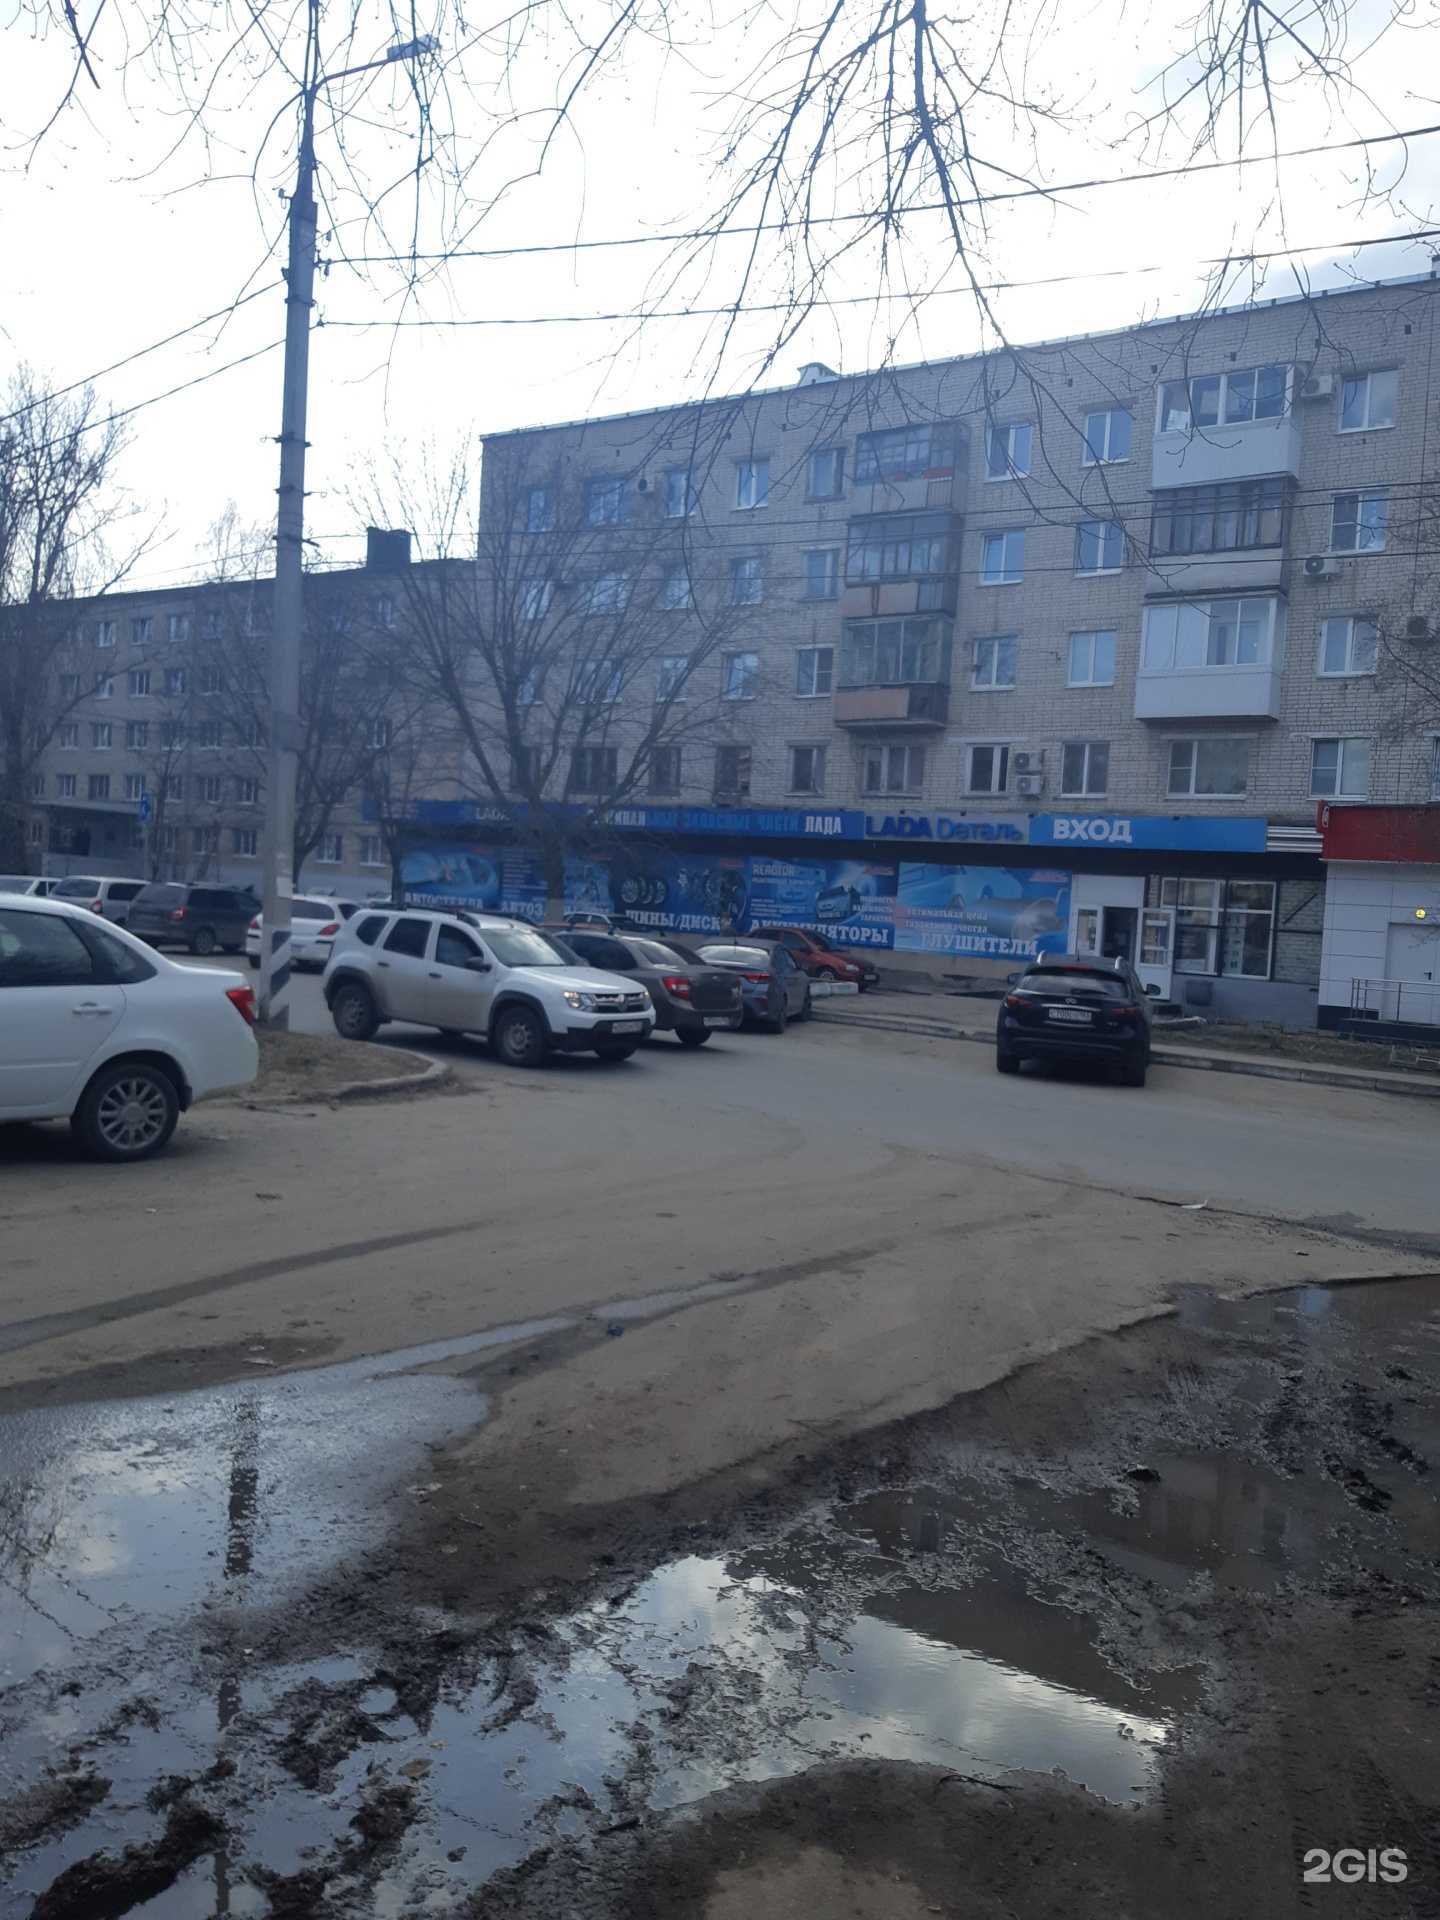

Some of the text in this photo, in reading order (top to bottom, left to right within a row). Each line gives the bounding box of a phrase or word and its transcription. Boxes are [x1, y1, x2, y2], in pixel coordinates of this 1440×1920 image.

[804, 815, 843, 835] ЛАДА
[865, 815, 932, 838] LADA
[1053, 818, 1133, 843] ВХОД
[501, 901, 544, 919] АВТОЗ
[919, 931, 1038, 956] ГЛУШИТЕЛИ
